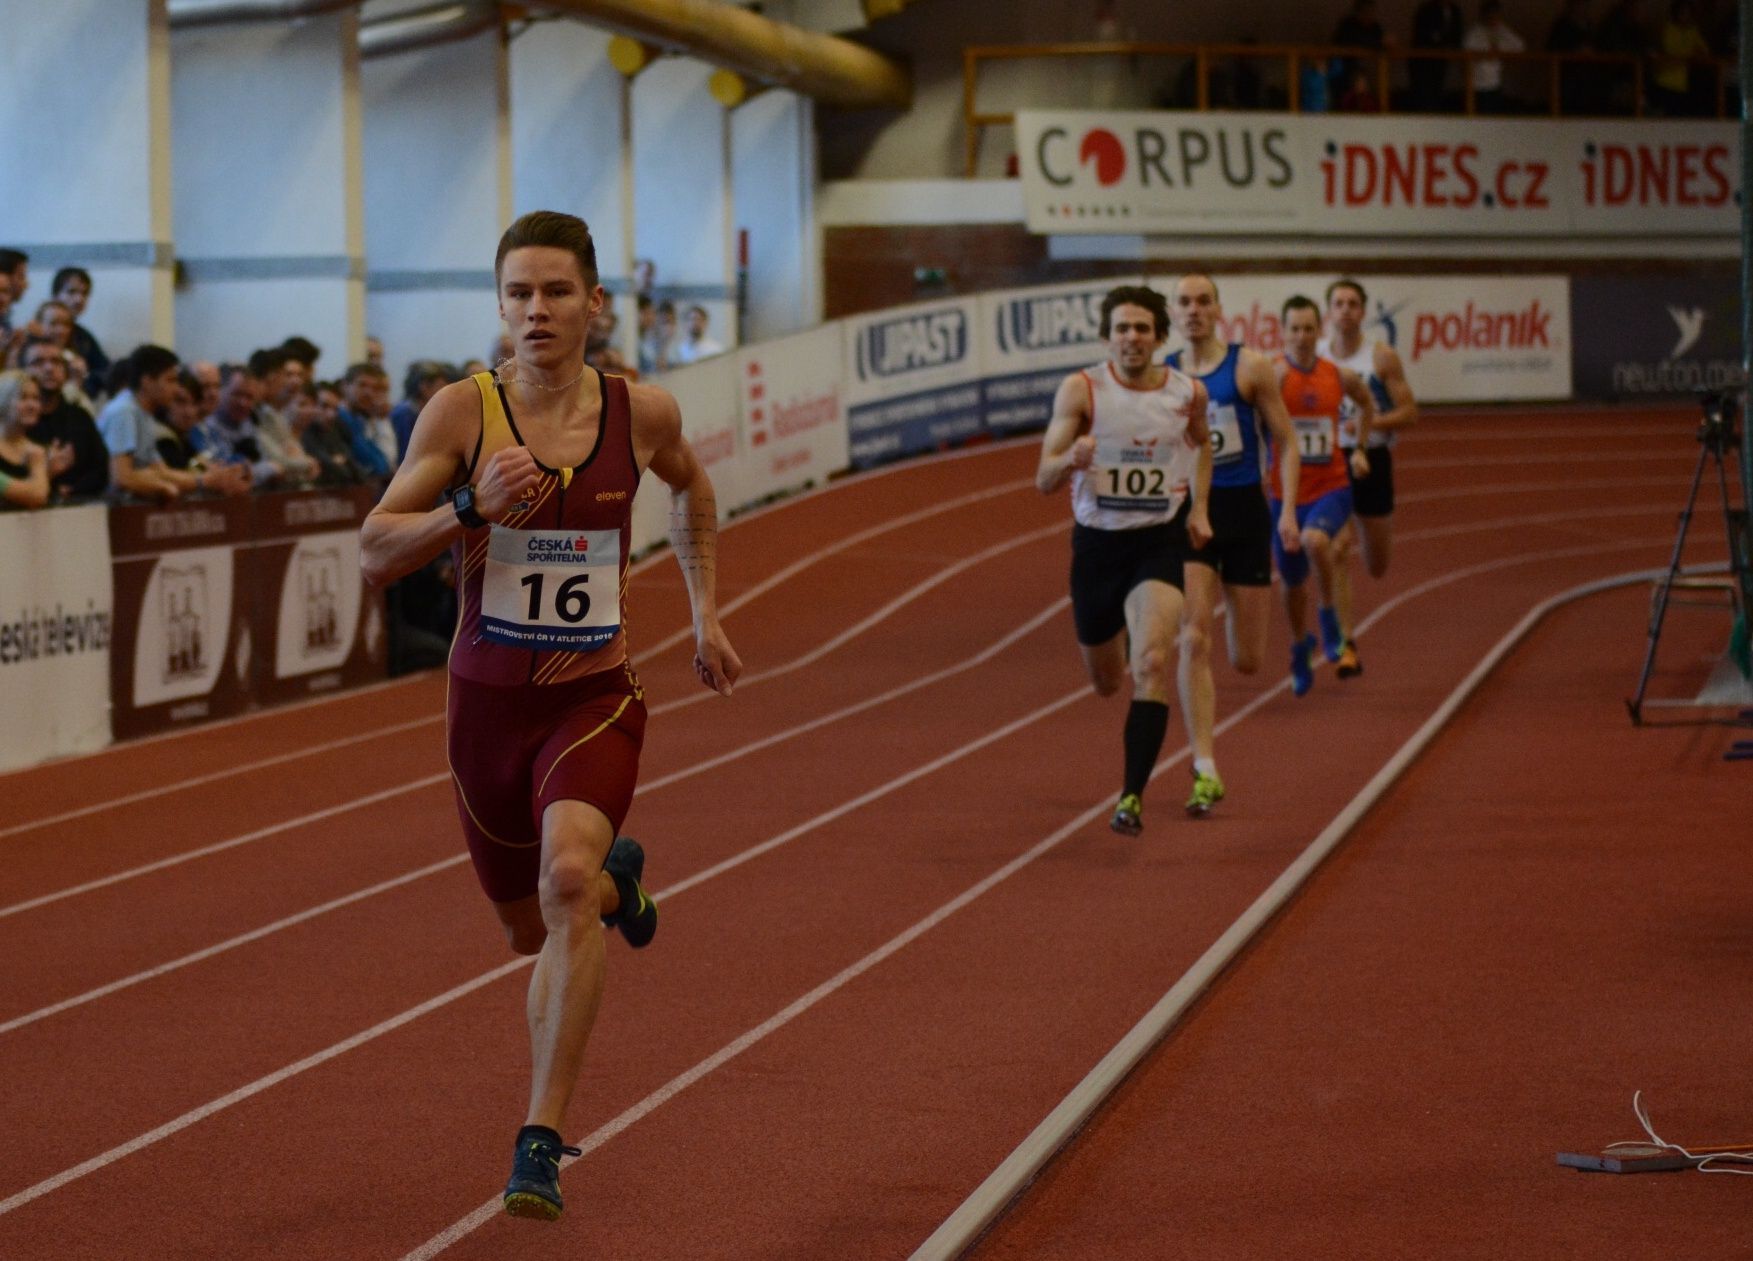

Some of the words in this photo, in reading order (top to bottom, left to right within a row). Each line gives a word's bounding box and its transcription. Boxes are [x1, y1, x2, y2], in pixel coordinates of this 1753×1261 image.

[1319, 141, 1550, 208] iDNES.cz
[1412, 299, 1551, 361] polanik
[1303, 432, 1328, 454] 11
[1107, 468, 1164, 496] 102
[595, 490, 627, 502] eleven
[528, 537, 573, 551] ČESKÁ
[526, 551, 587, 563] SPOŘITELNA
[521, 573, 591, 623] 16
[486, 624, 535, 641] MISTROVSTVÍ
[537, 632, 548, 641] ČR
[557, 635, 592, 643] ATLETICE
